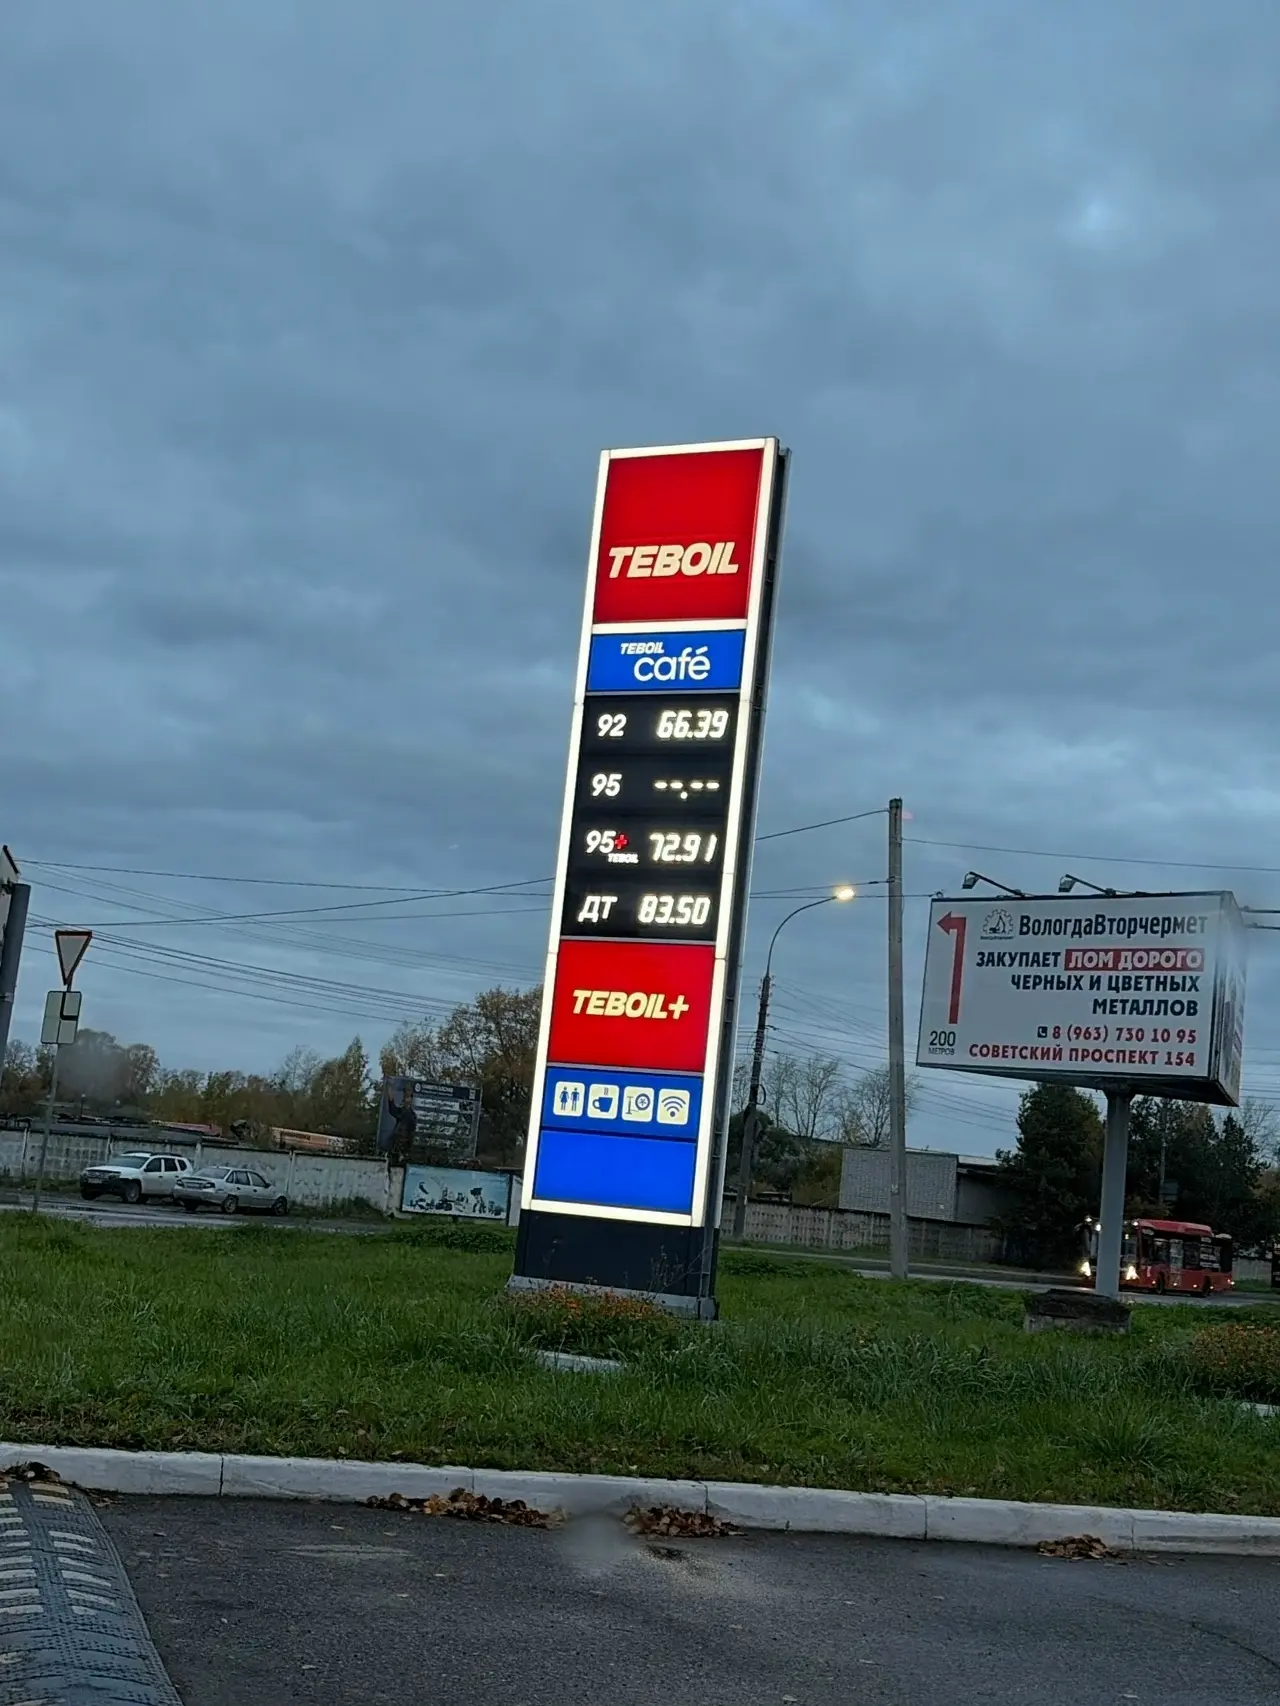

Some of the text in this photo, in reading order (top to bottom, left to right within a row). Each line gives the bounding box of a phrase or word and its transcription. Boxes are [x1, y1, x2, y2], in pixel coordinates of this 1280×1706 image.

[608, 541, 739, 579] TEBOIL
[620, 641, 665, 655] TEBOIL
[633, 646, 711, 682] café
[597, 710, 729, 739] 92 66.39
[591, 773, 622, 797] 95
[607, 852, 639, 864] TEBOIL
[649, 832, 717, 863] 72.91
[577, 895, 711, 925] ДТ 83.50
[1019, 914, 1208, 939] ВологдаВторчермет
[976, 950, 1203, 971] ЗАКУПАЕТ ЛОМ ДОРОГО
[1011, 974, 1200, 993] ЧЕРНЫХ И ЦВЕТНЫХ
[572, 989, 690, 1020] TEBOIL+
[1092, 998, 1199, 1016] МЕТАЛЛОВ
[929, 1030, 956, 1047] 200
[1052, 1024, 1197, 1044] 8 (963) 730 10 95
[928, 1047, 955, 1056] МЕТРОВ
[969, 1043, 1195, 1067] СОВЕТСКИЙ ПРОСПЕКТ 154
